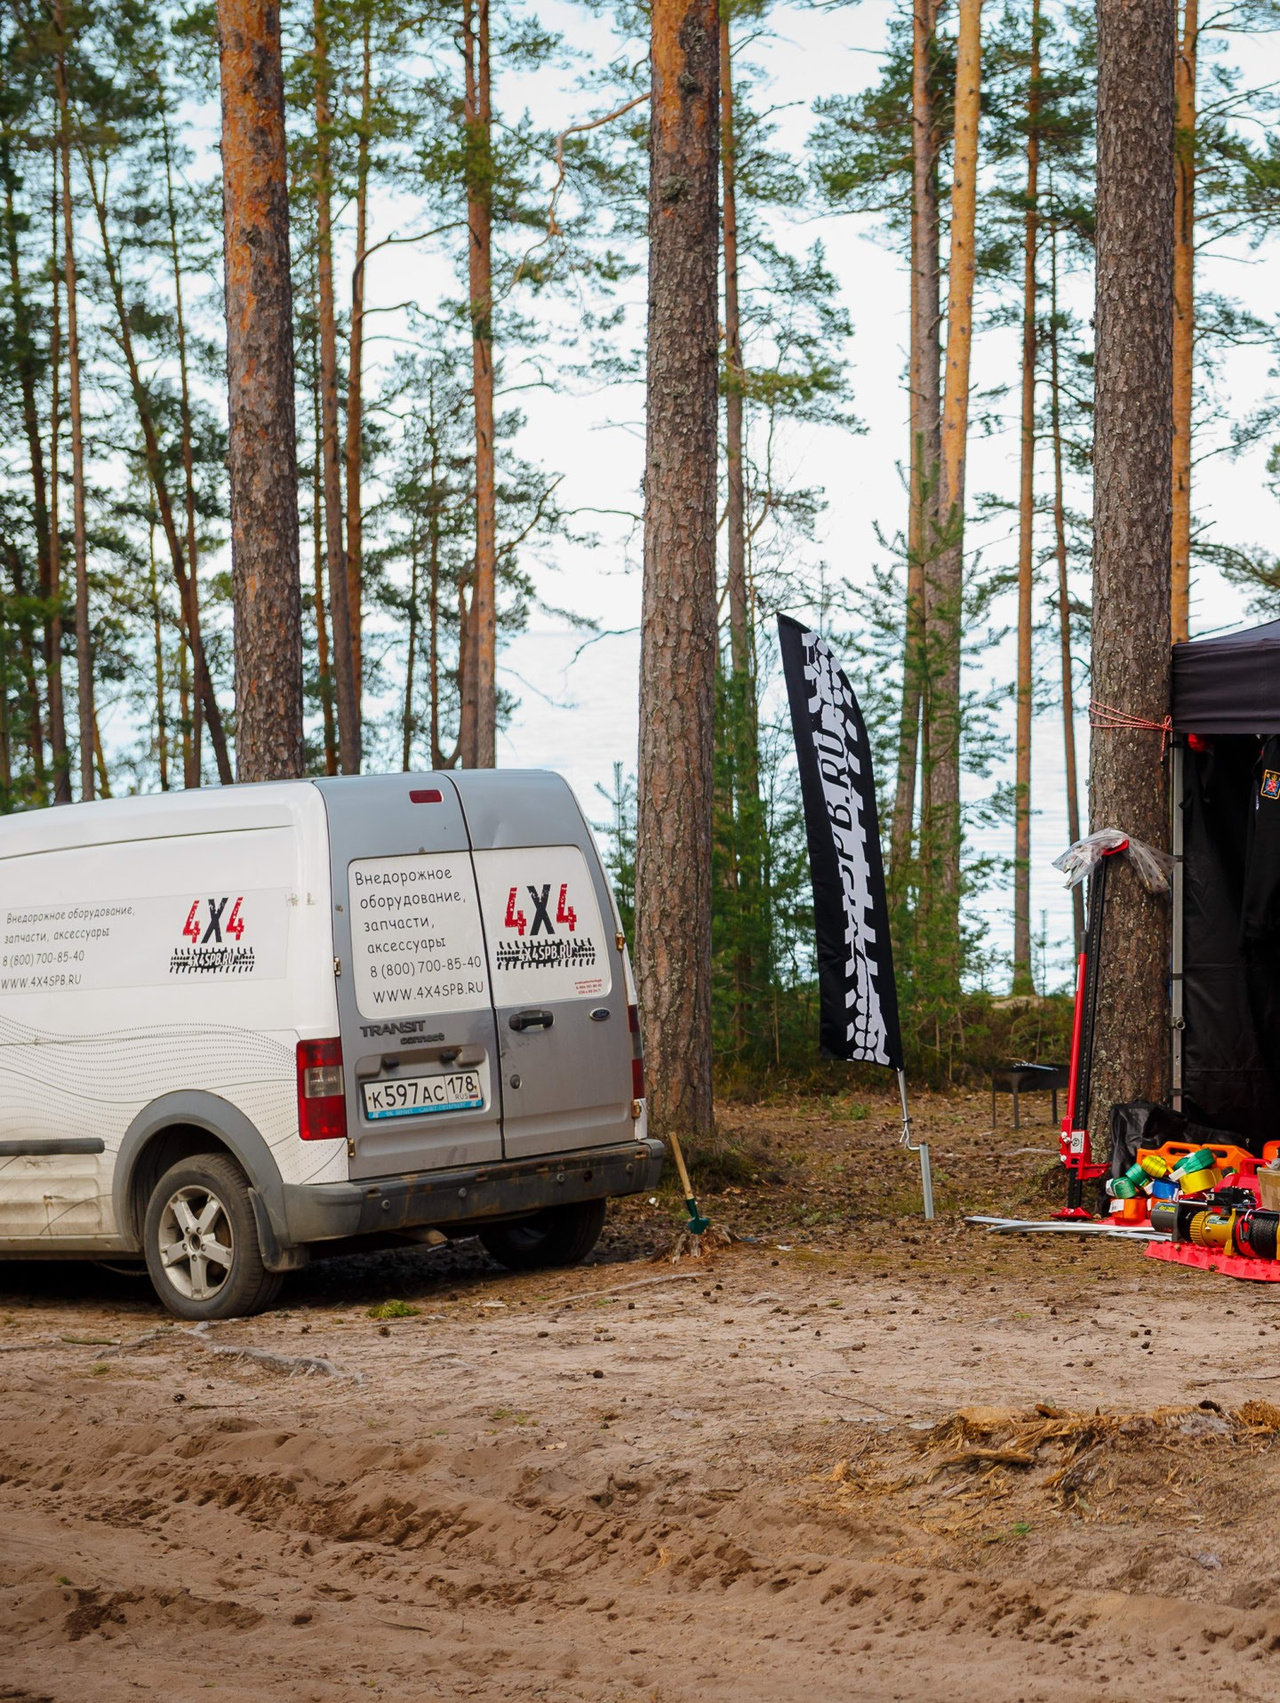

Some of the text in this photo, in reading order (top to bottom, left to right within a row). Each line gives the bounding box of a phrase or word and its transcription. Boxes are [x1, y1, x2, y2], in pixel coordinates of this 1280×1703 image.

[355, 869, 453, 886] Внедорожное
[360, 891, 466, 911] оборудование,
[504, 883, 577, 936] 4X4
[6, 911, 66, 925] Внедорожное
[182, 896, 244, 944] 4X4
[364, 917, 435, 932] запчасти,
[4, 927, 110, 944] запчасти, аксессуары
[367, 938, 446, 954] аксессуары
[2, 949, 85, 968] 8 (800) 700-85-40
[370, 956, 482, 979] 8 (800) 700-85-40
[0, 974, 82, 990] WWW.4X4SPB.RU
[373, 981, 484, 1003] WWW.4X4SPB.RU
[360, 1020, 426, 1037] TRANSIT
[447, 1075, 474, 1094] 178
